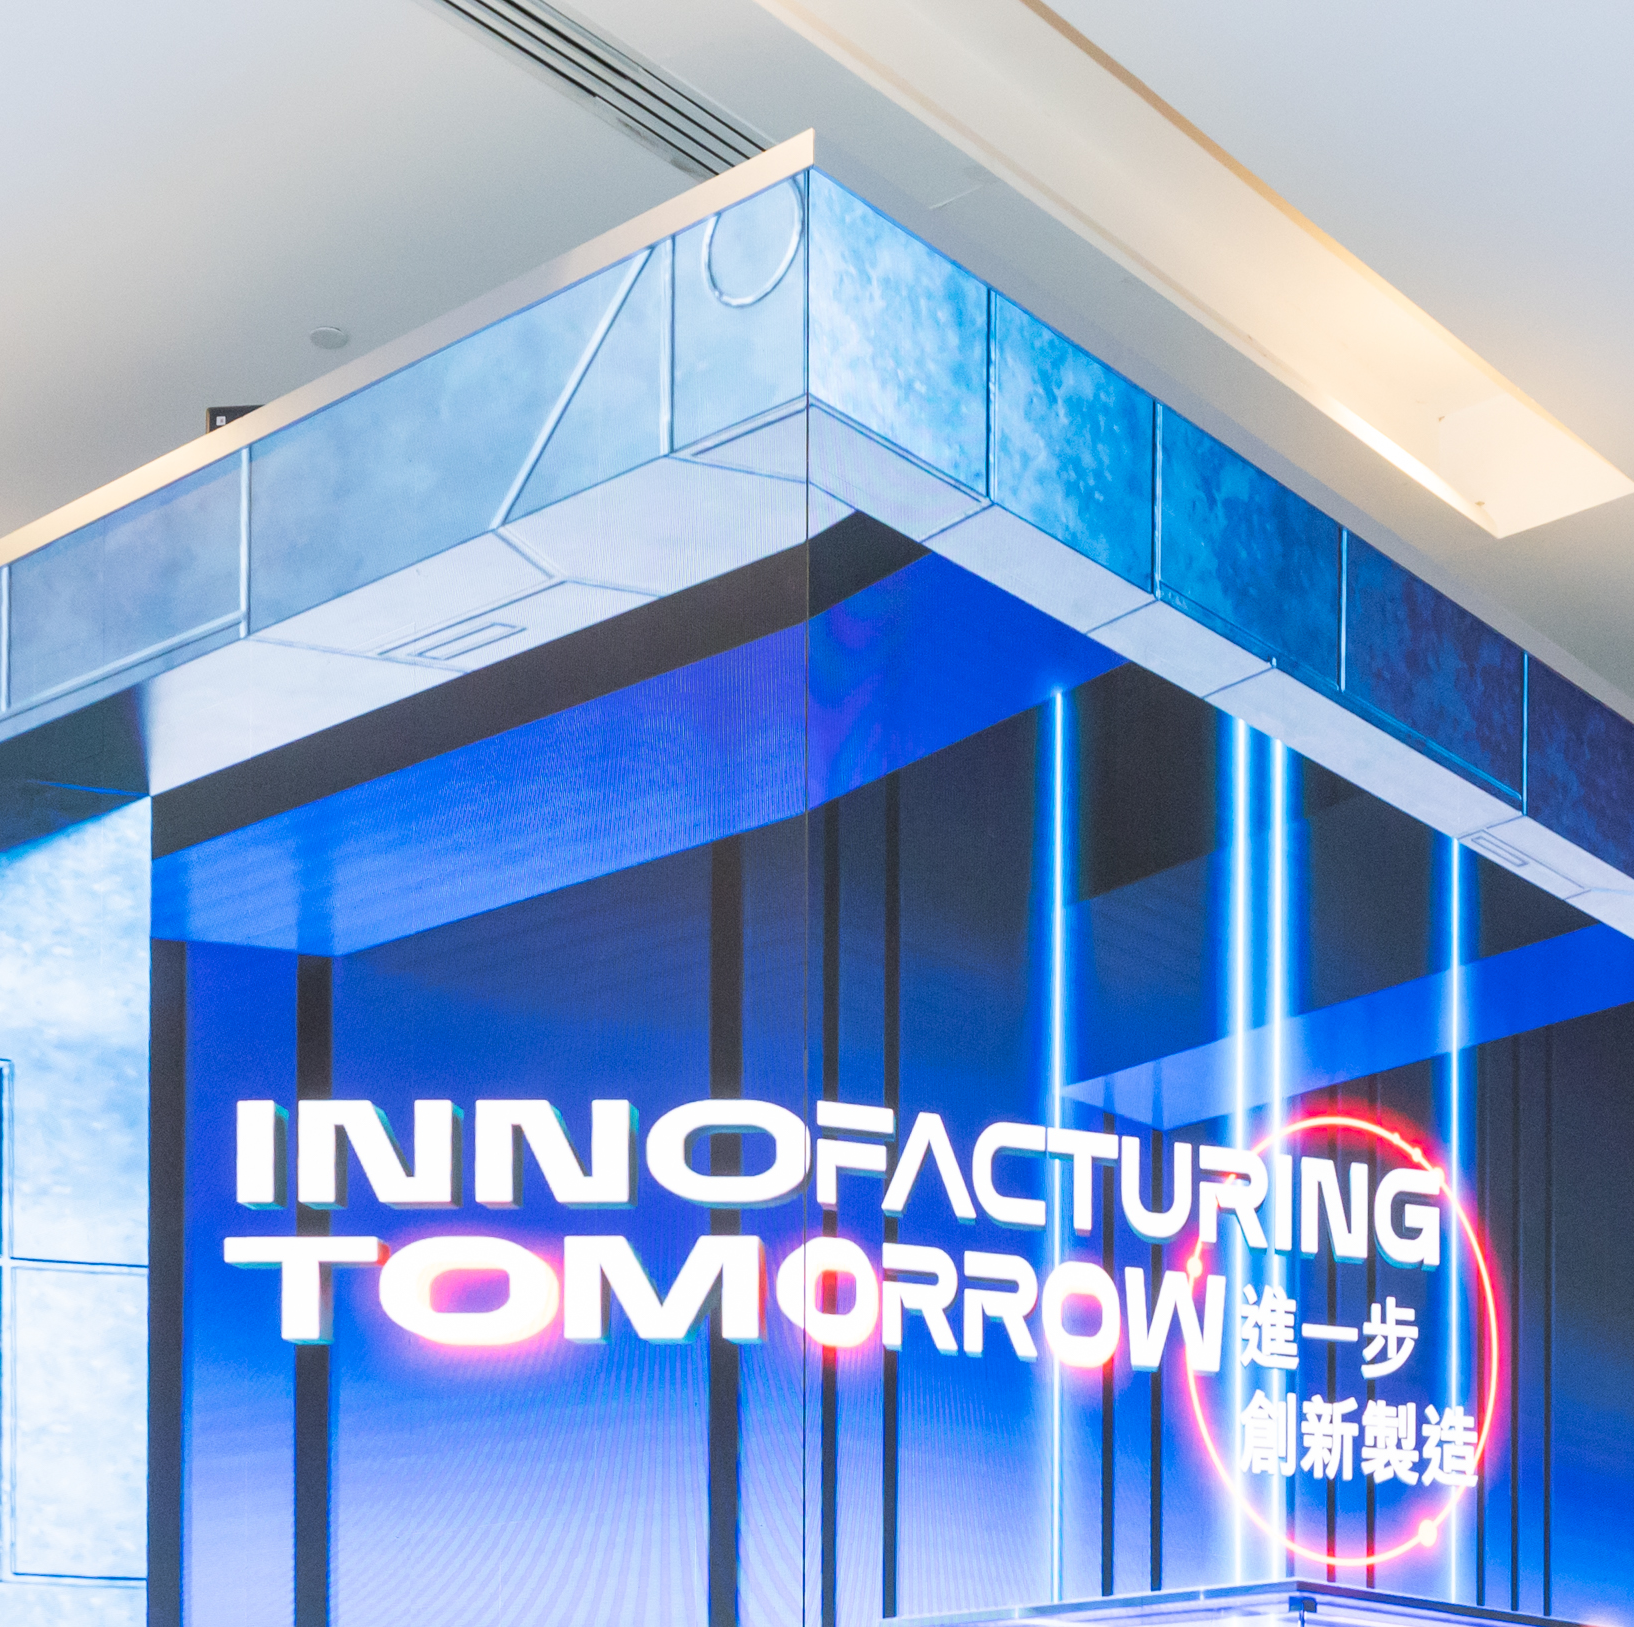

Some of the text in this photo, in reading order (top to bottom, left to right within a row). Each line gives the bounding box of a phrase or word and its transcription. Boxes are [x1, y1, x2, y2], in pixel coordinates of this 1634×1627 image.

[235, 1097, 1443, 1270] INNOFACTURING
[224, 1236, 1225, 1376] TOMORROW
[1240, 1283, 1419, 1380] 進一步
[1240, 1387, 1479, 1490] 創新製造
